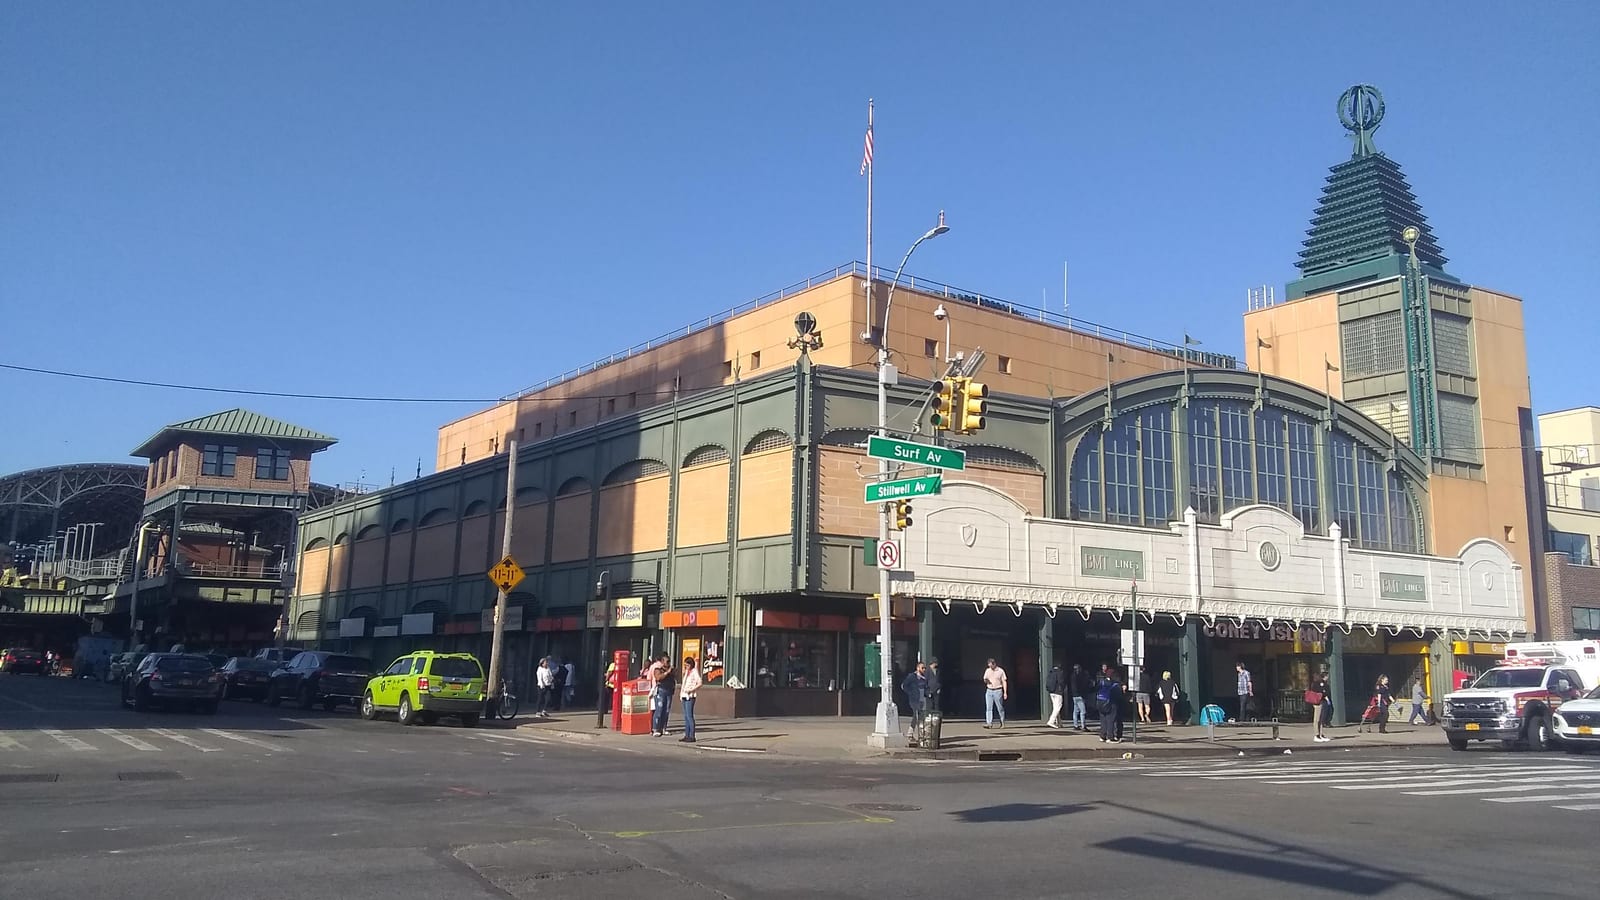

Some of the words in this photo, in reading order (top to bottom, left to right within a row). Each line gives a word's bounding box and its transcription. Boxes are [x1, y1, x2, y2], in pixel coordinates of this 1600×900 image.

[894, 445, 920, 459] Surf
[926, 451, 941, 462] Av
[878, 484, 909, 497] Stillwell
[915, 482, 926, 492] Av
[1084, 553, 1109, 570] BMT
[1382, 578, 1401, 593] BMT
[1404, 583, 1423, 592] LINES
[1202, 622, 1260, 639] CONEY
